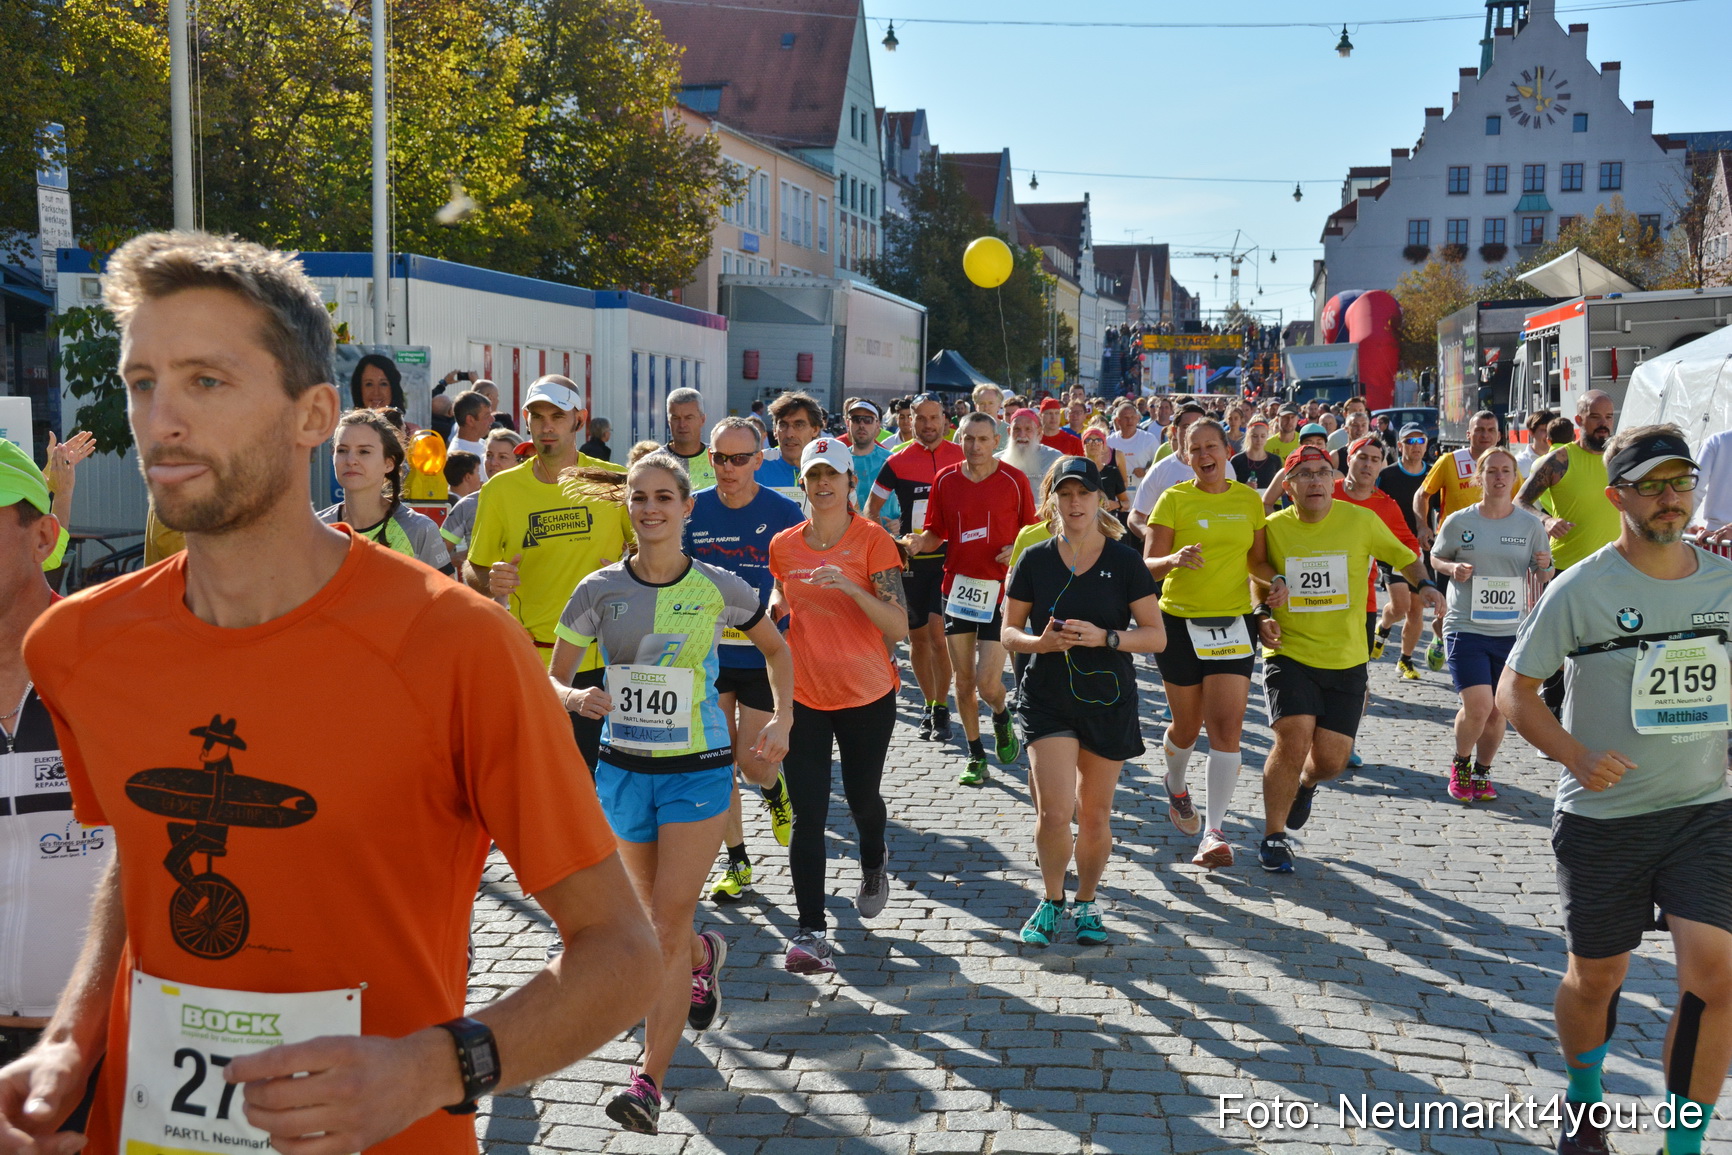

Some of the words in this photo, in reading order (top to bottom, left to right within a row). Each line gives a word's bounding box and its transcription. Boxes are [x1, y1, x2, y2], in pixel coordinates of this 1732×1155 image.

[41, 203, 69, 215] Parkschein
[44, 216, 68, 227] werktags
[1174, 337, 1210, 347] START
[815, 440, 828, 454] B
[538, 512, 580, 525] RECHARGE
[534, 520, 587, 534] ENDORPHINS
[1500, 536, 1526, 545] BOCK
[1302, 560, 1329, 568] BOCK
[1300, 571, 1331, 589] 291
[956, 585, 989, 605] 2451
[1304, 597, 1333, 606] Thomas
[1480, 589, 1516, 605] 3002
[960, 608, 979, 617] Martin
[721, 629, 740, 639] stian
[1207, 627, 1228, 641] 11
[1668, 632, 1696, 640] sailfish
[1211, 647, 1236, 656] Andrea
[1665, 647, 1707, 660] BOCK
[631, 671, 667, 683] BOCK
[1649, 663, 1717, 696] 2159
[620, 686, 678, 716] 3140
[1677, 697, 1704, 705] Neumarkt
[623, 715, 639, 723] PARTL
[640, 717, 665, 725] Neumarkt
[1657, 710, 1708, 724] Matthias
[53, 840, 74, 848] fitness
[76, 837, 104, 846] paradies
[181, 1003, 283, 1037] BOCK
[181, 1030, 209, 1040] inspired
[211, 1033, 220, 1042] by
[221, 1036, 244, 1044] smart
[246, 1038, 284, 1046] concepts
[170, 1047, 239, 1120] 27
[164, 1124, 210, 1142] PARTL
